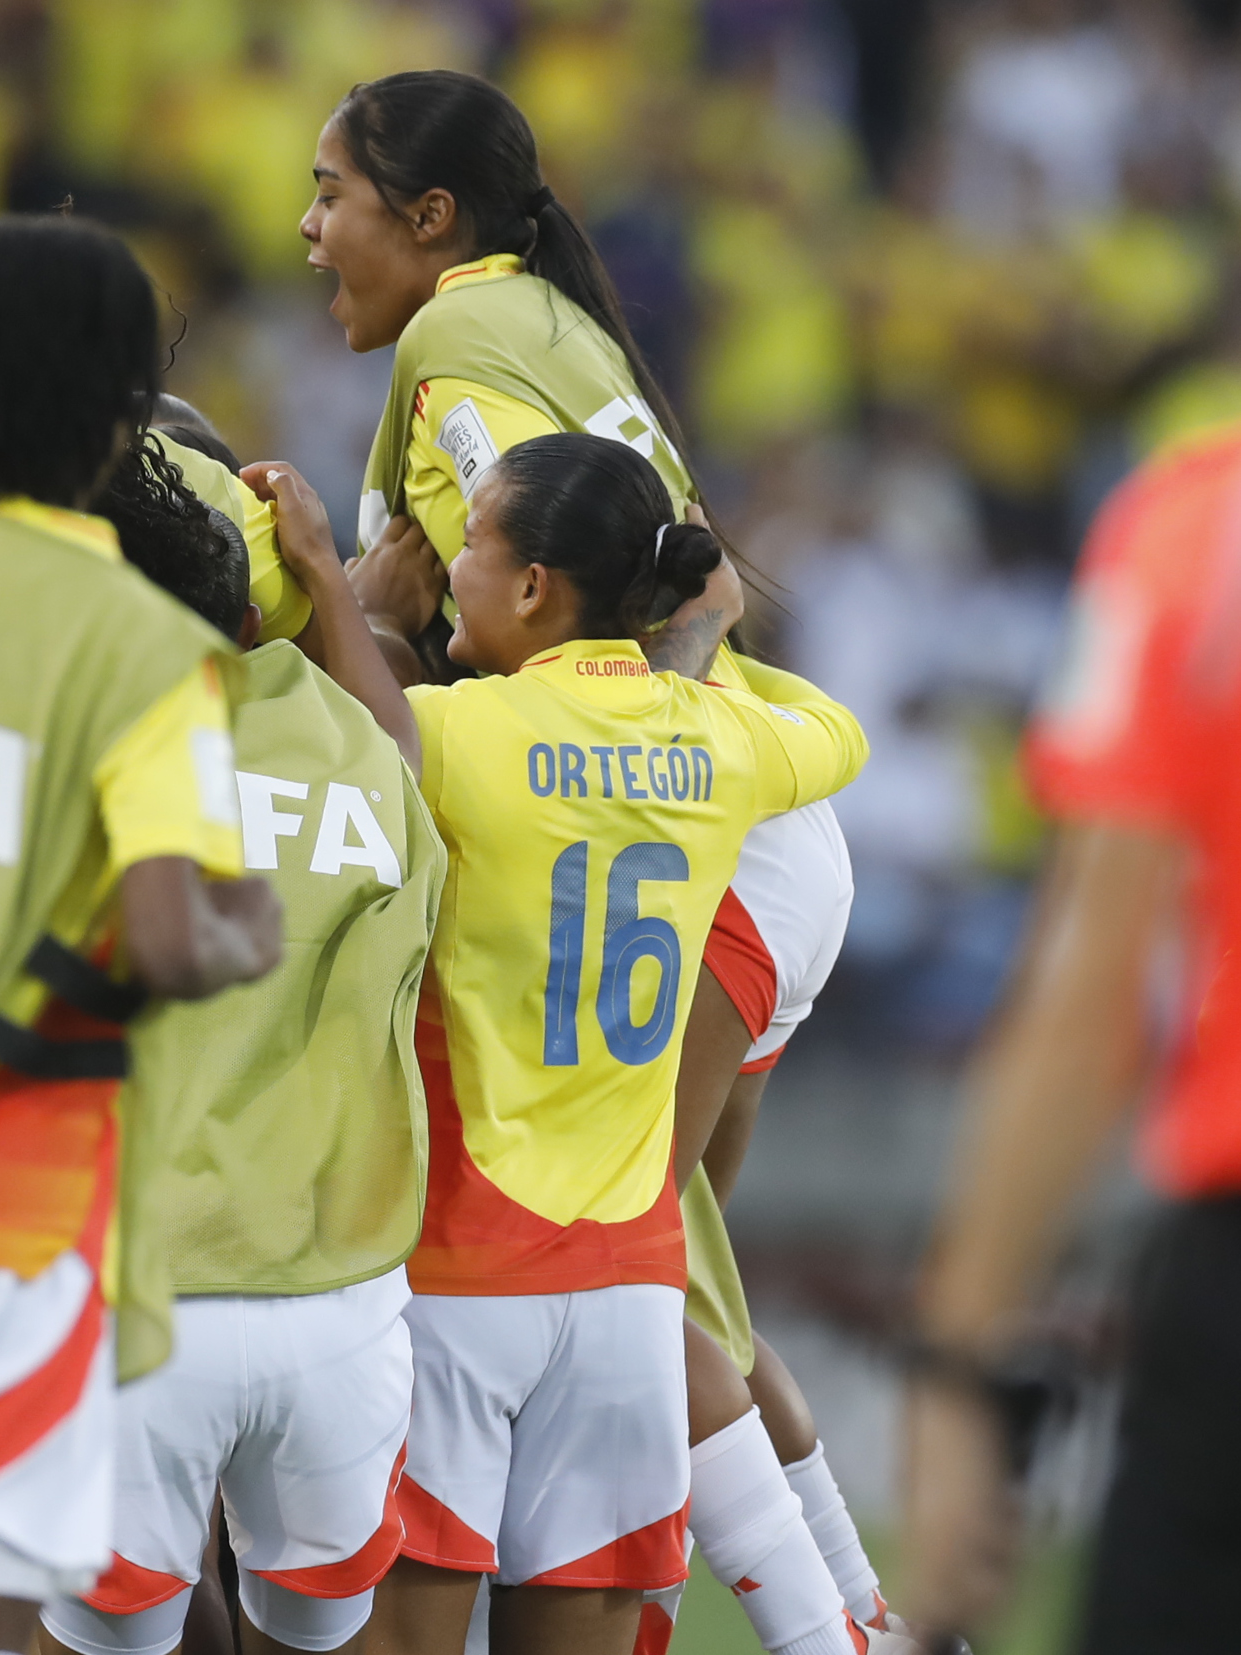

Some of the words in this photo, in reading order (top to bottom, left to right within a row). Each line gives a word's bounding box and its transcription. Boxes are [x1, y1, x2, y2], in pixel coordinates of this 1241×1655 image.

[575, 660, 650, 677] COLOMBIA
[527, 733, 713, 802] ORTEGÓN
[235, 770, 403, 889] FA
[543, 840, 690, 1066] 16
